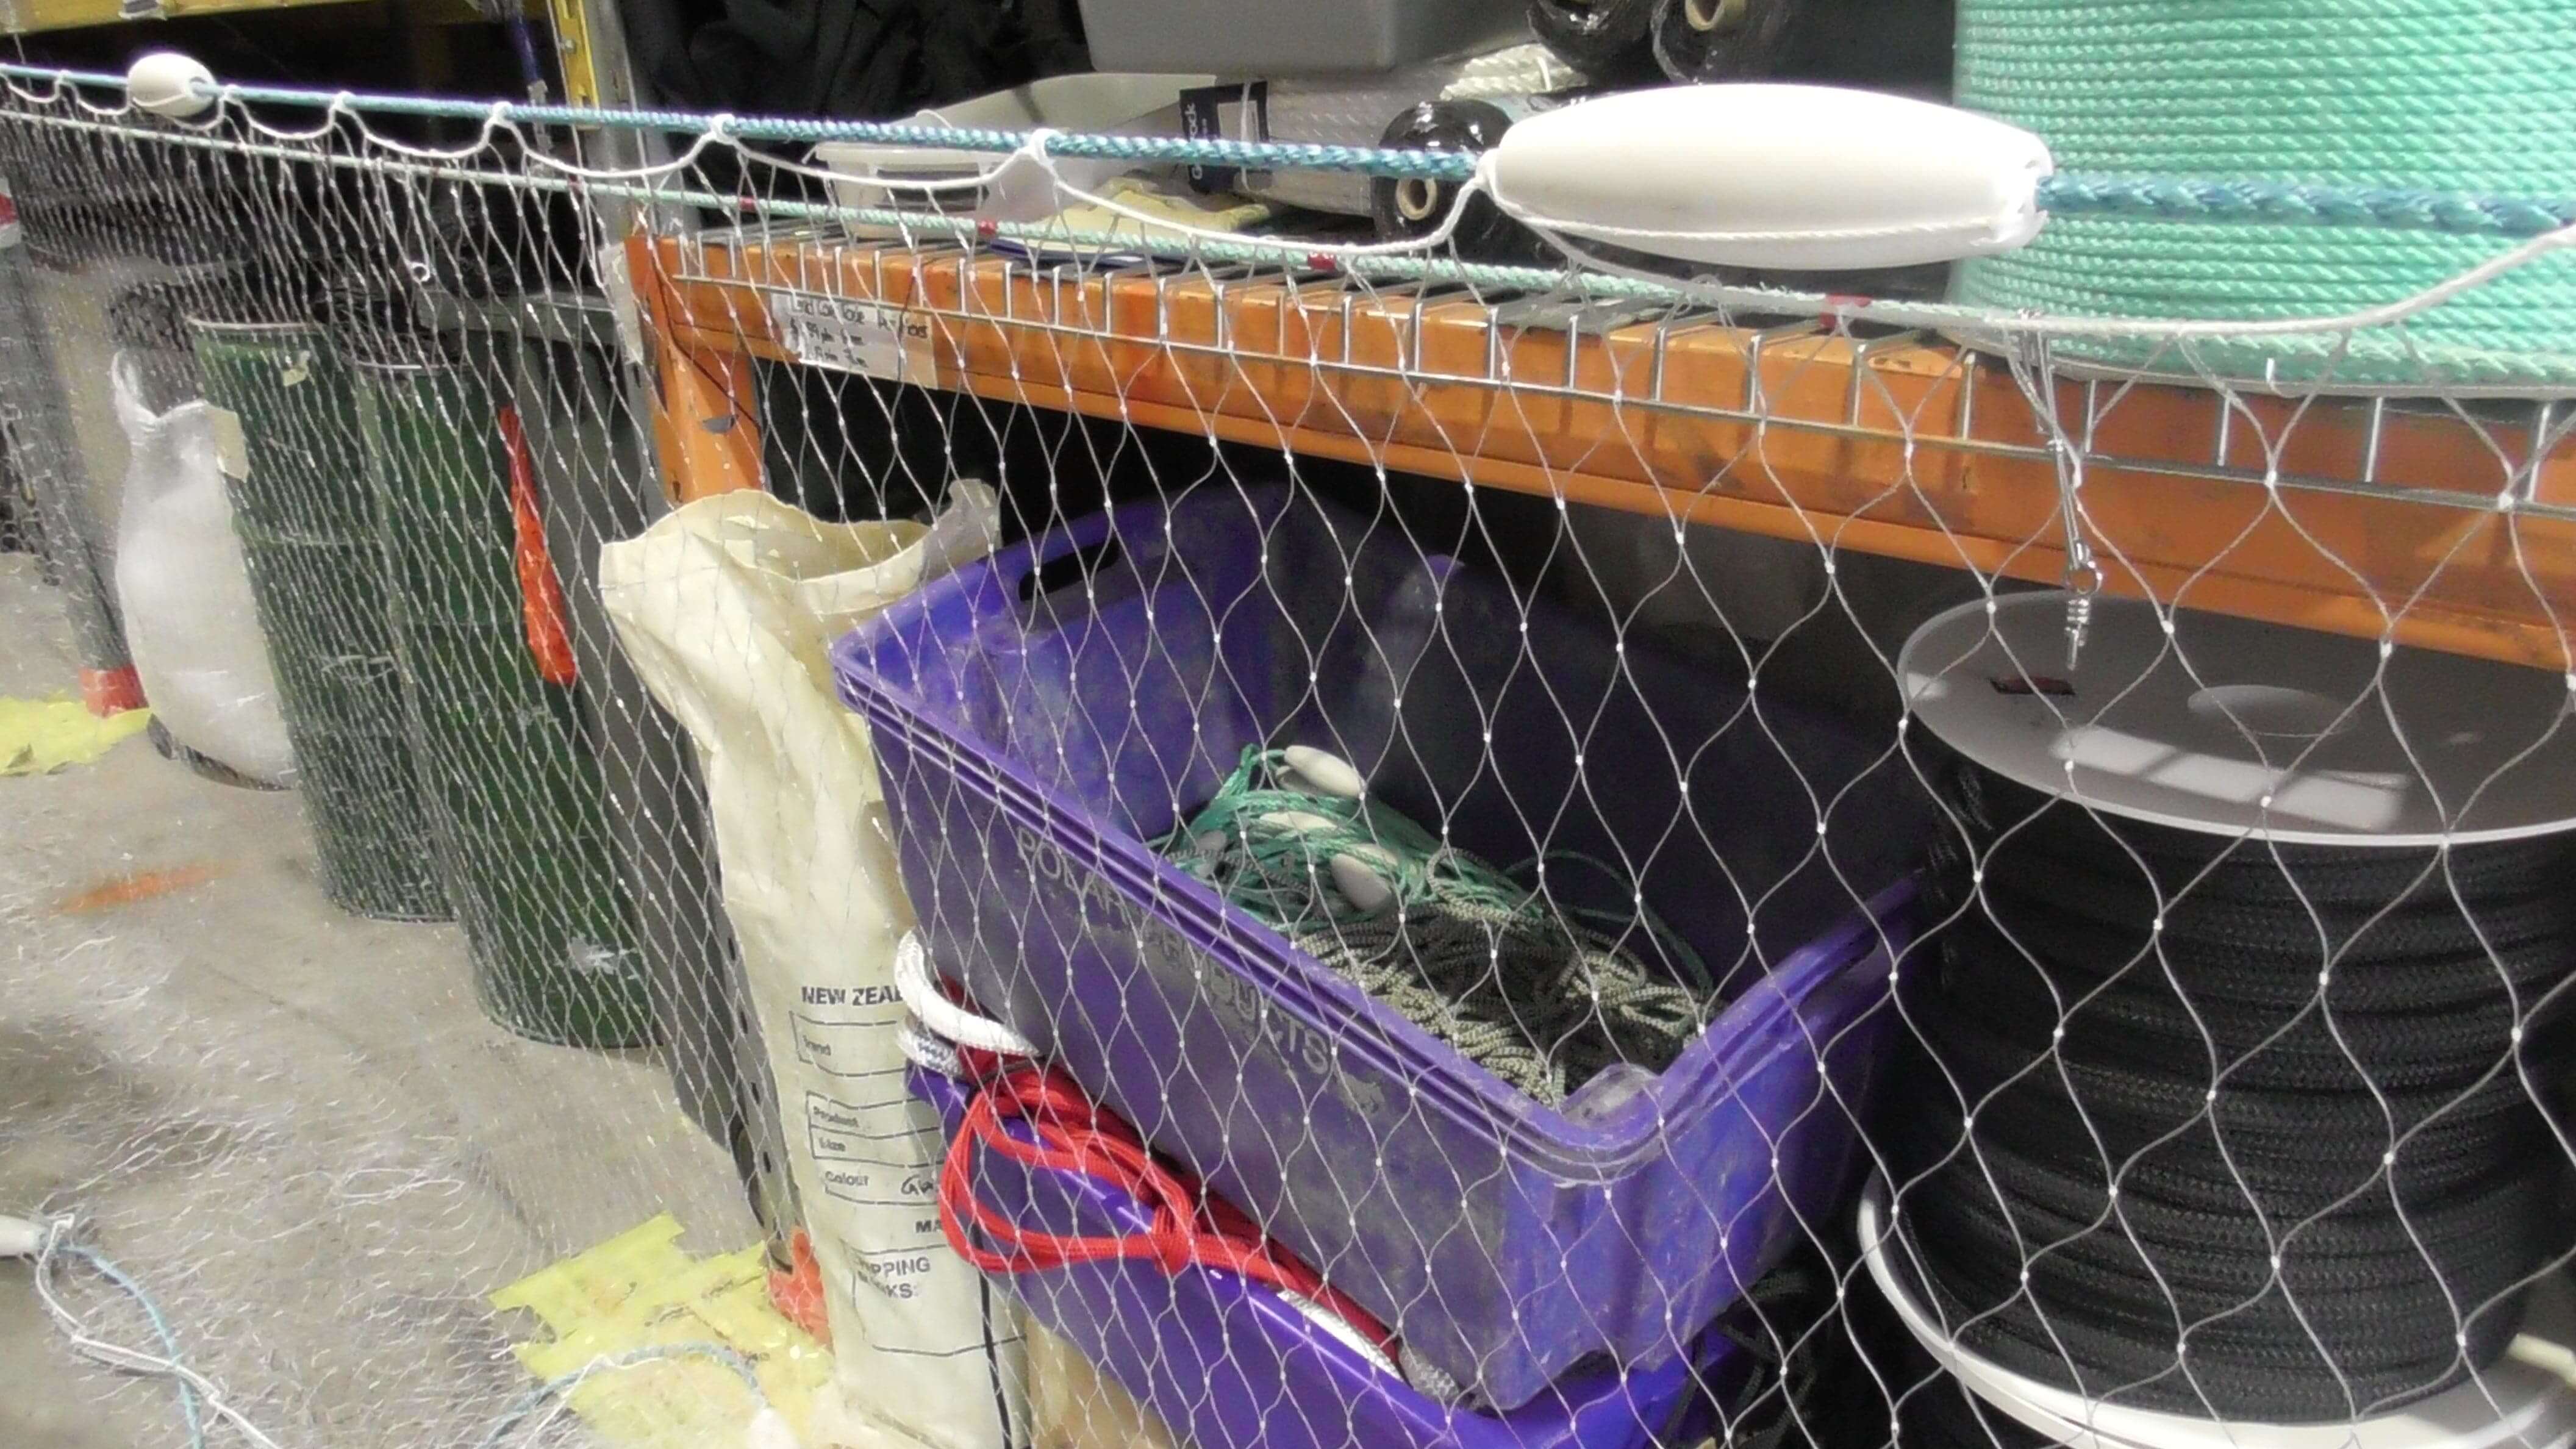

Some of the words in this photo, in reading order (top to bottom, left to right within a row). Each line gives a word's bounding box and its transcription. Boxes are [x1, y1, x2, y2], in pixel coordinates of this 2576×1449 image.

[801, 986, 846, 1006] NEW
[825, 1170, 870, 1186] Colour
[856, 1256, 931, 1278] PPING
